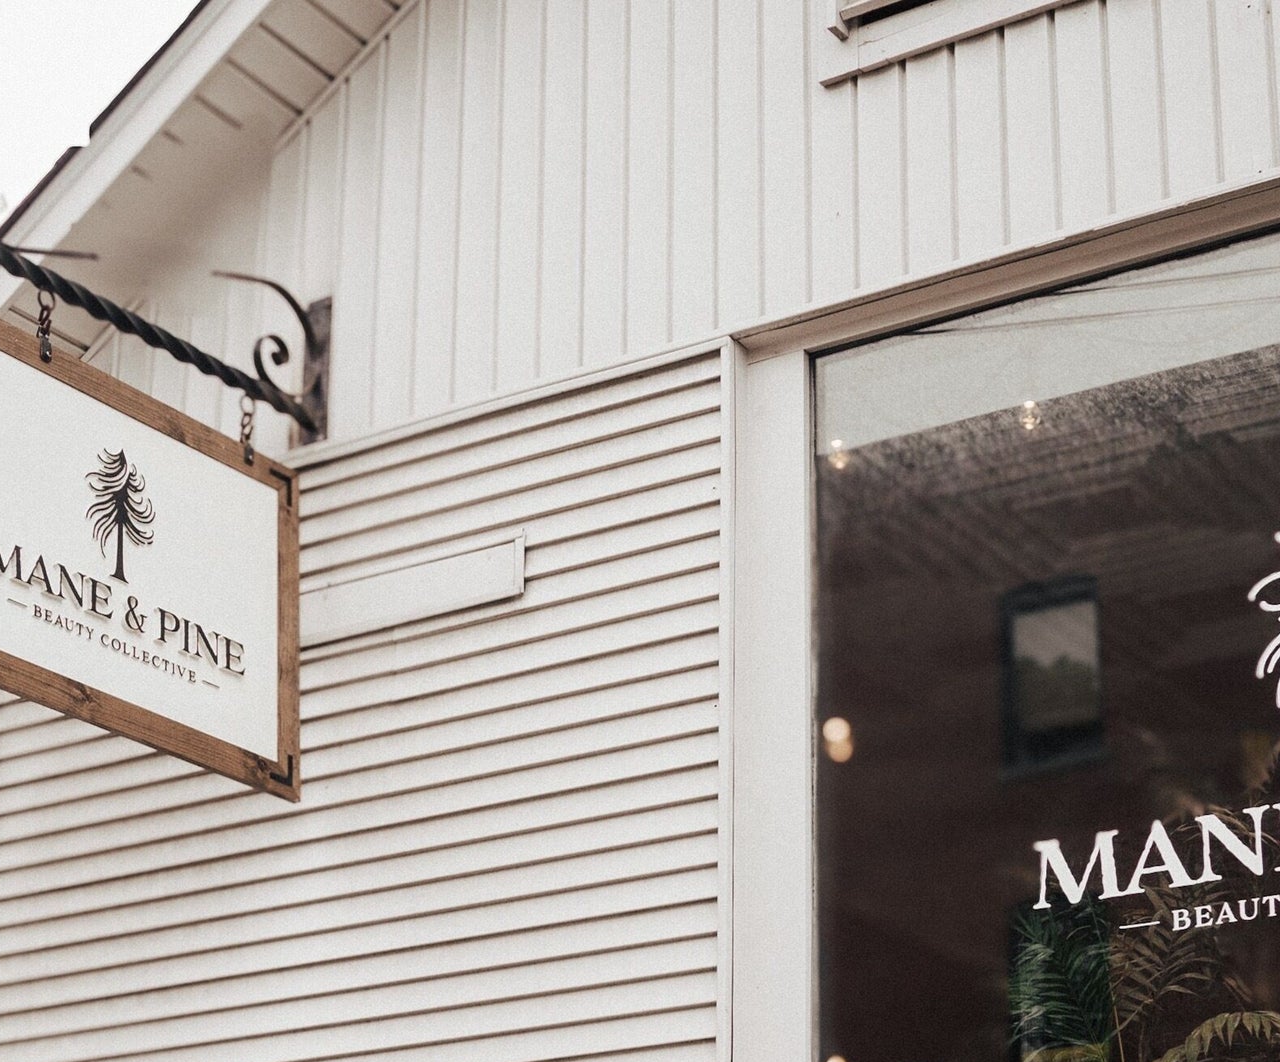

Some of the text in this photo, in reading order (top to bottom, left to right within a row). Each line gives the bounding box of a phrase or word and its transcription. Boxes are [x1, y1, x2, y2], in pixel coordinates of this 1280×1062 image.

[32, 604, 198, 684] BEAUTY COLLECTIVE
[124, 594, 147, 634] &
[154, 606, 249, 678] PINE
